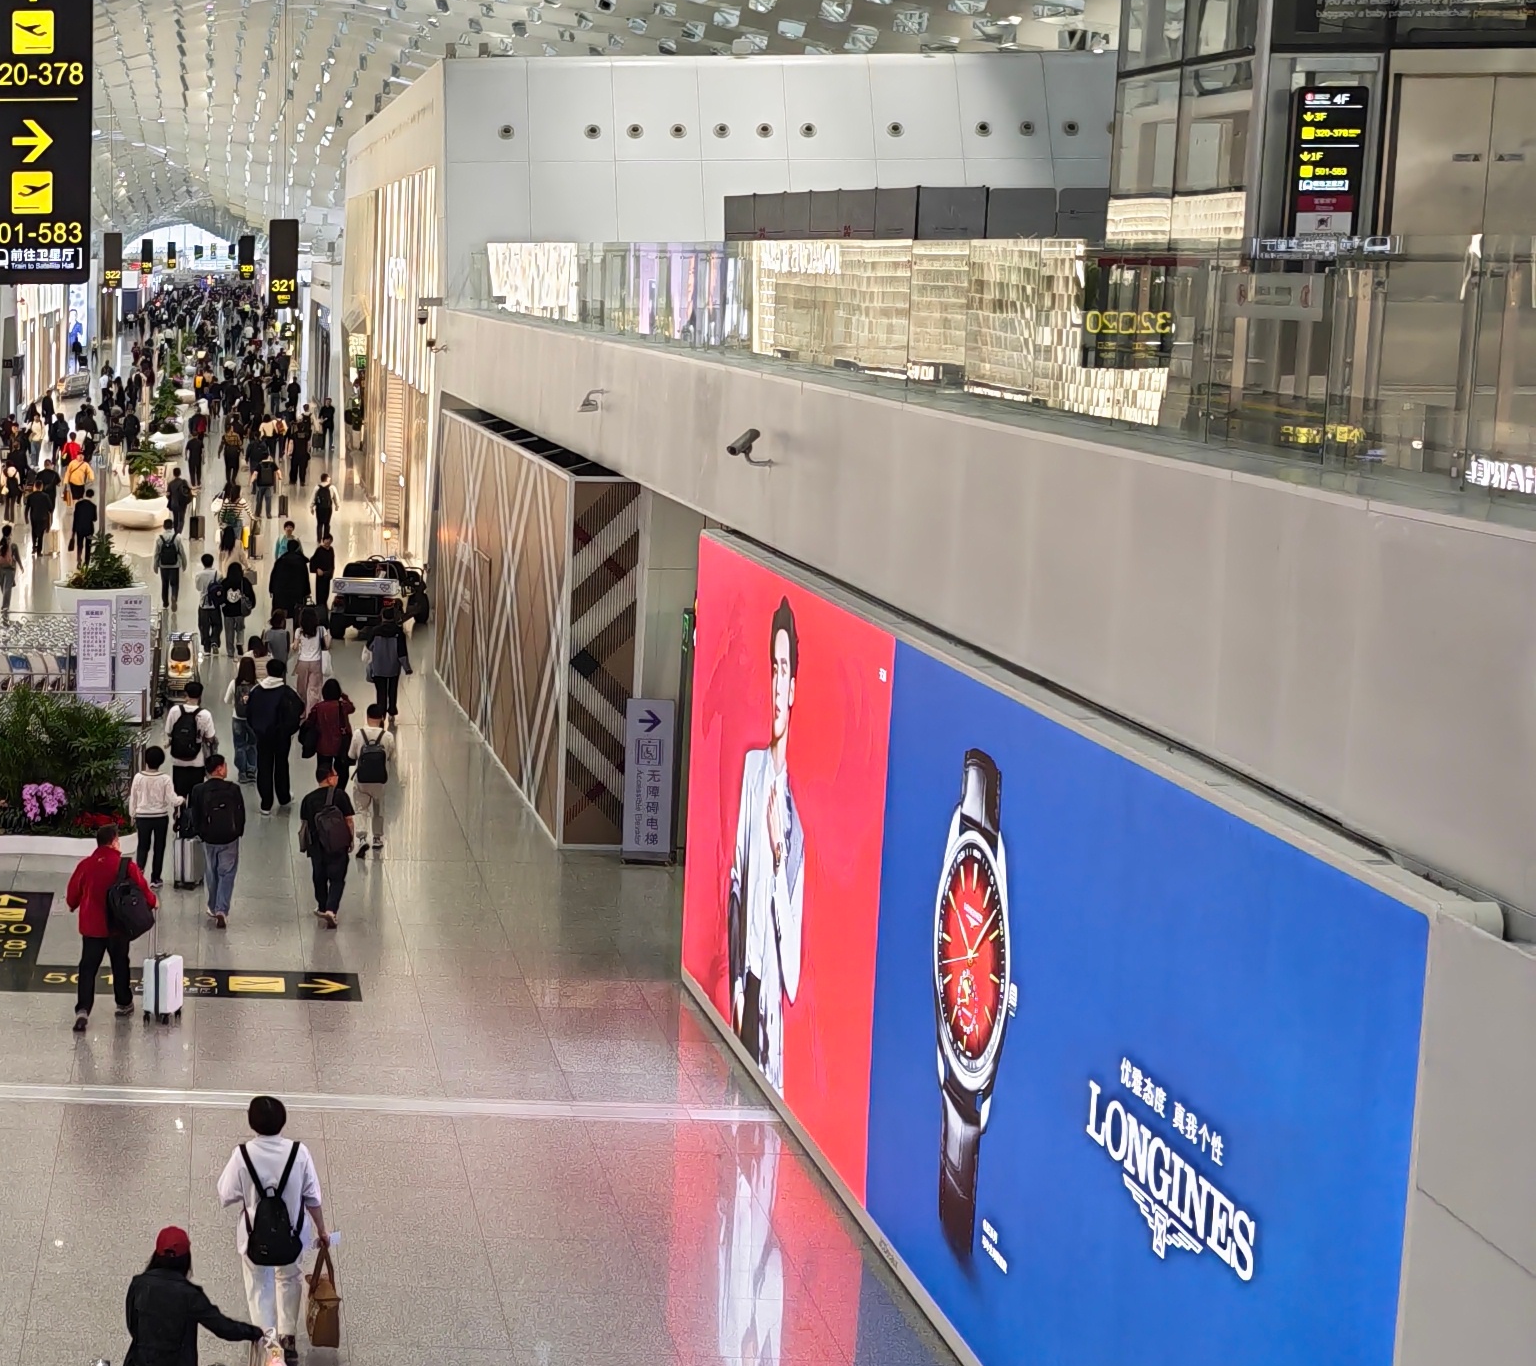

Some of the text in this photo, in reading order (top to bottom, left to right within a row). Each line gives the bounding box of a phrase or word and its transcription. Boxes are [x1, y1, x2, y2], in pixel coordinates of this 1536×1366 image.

[11, 248, 75, 262] 前往卫星厅
[105, 270, 122, 279] 322
[271, 279, 296, 292] 321
[645, 769, 662, 846] 无障碍电梯
[1172, 1101, 1225, 1167] 真我个性
[1086, 1079, 1256, 1282] LONGINES
